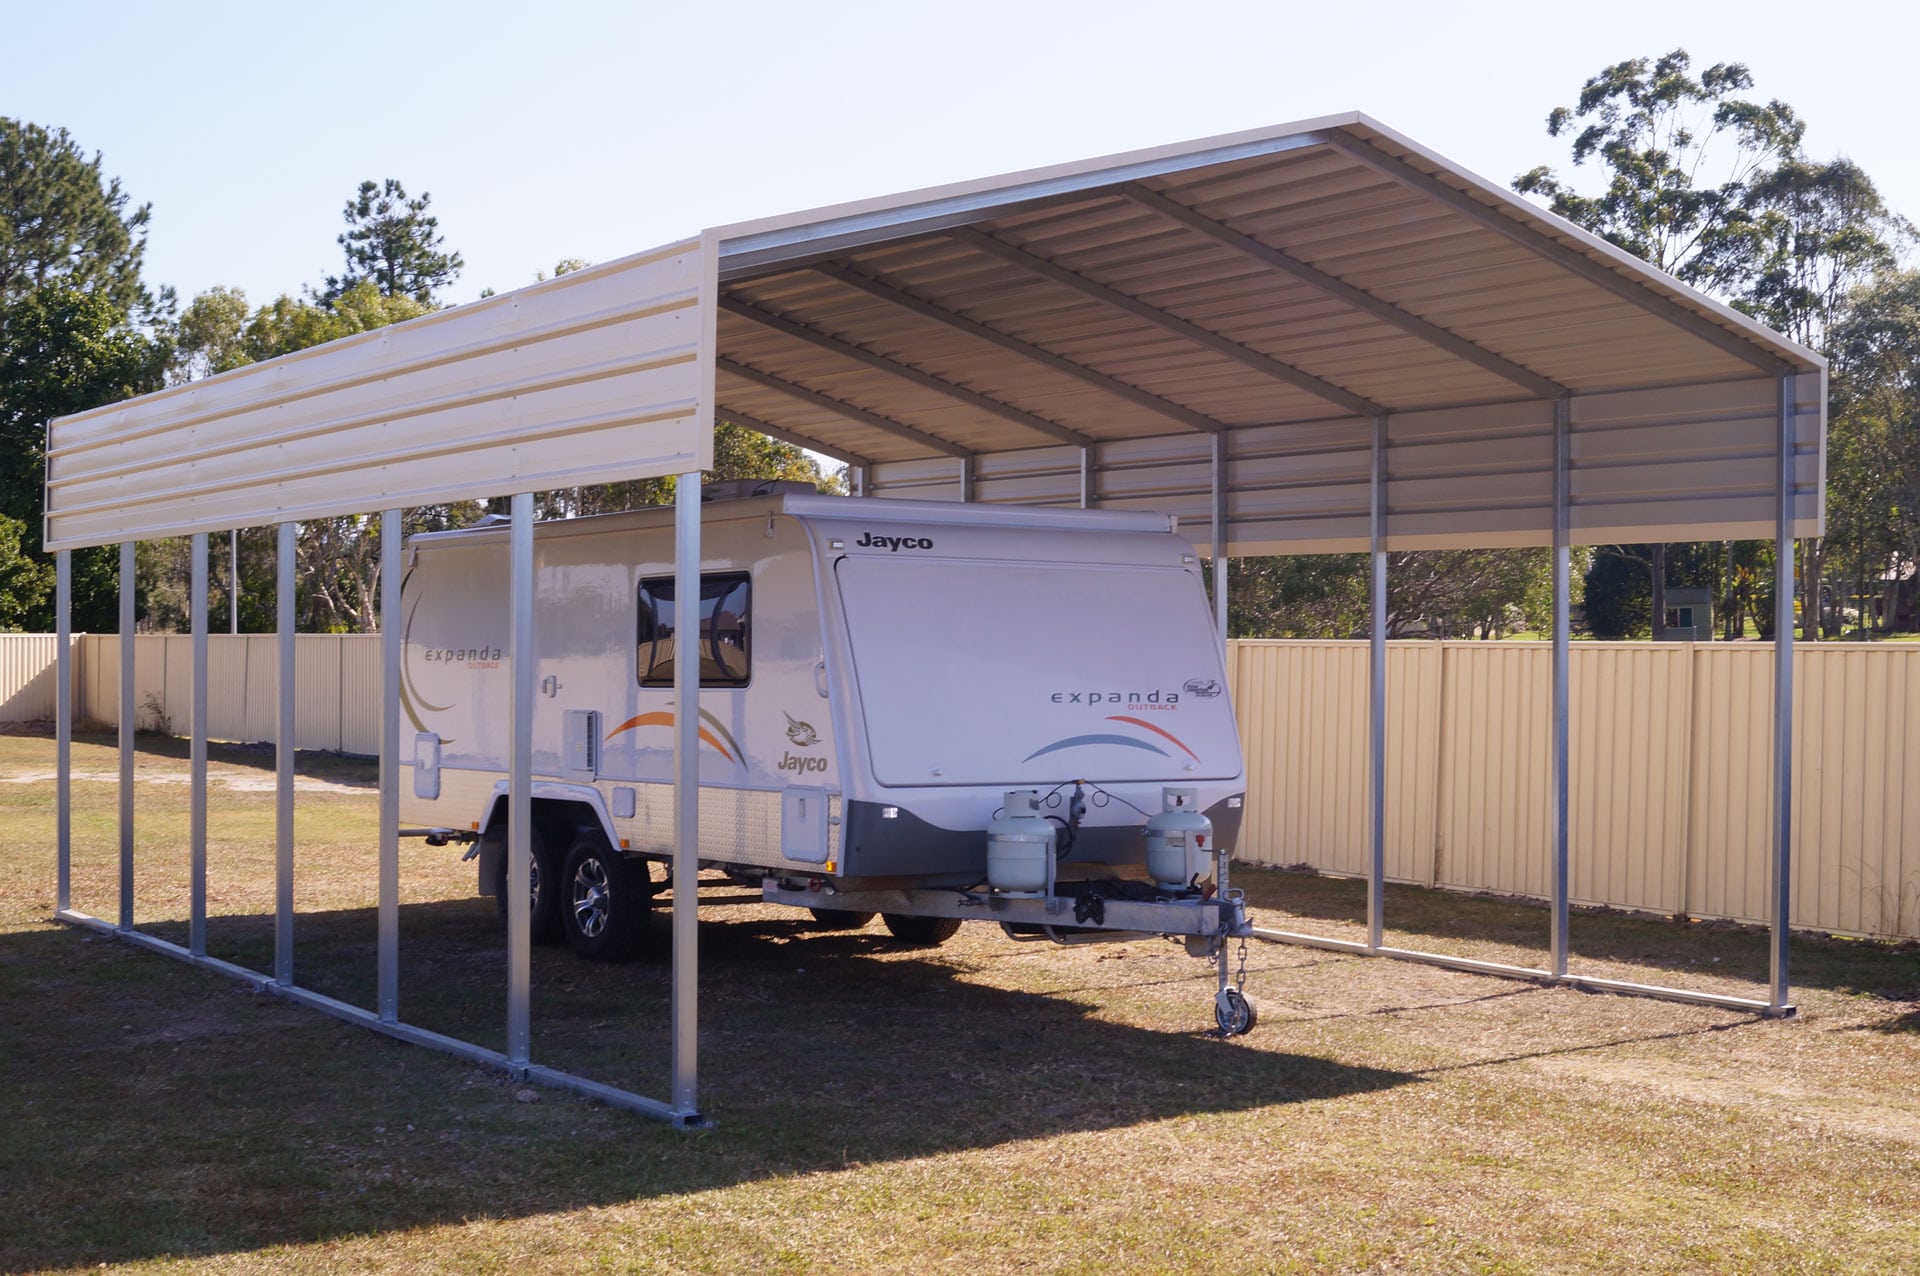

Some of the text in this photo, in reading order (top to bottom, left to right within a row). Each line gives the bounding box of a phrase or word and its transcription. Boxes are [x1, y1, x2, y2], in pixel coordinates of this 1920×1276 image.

[856, 531, 933, 552] Jayco
[425, 645, 502, 664] expanda
[1051, 689, 1179, 706] expanda
[1127, 703, 1177, 711] OUTBACK
[777, 751, 828, 775] Jayco
